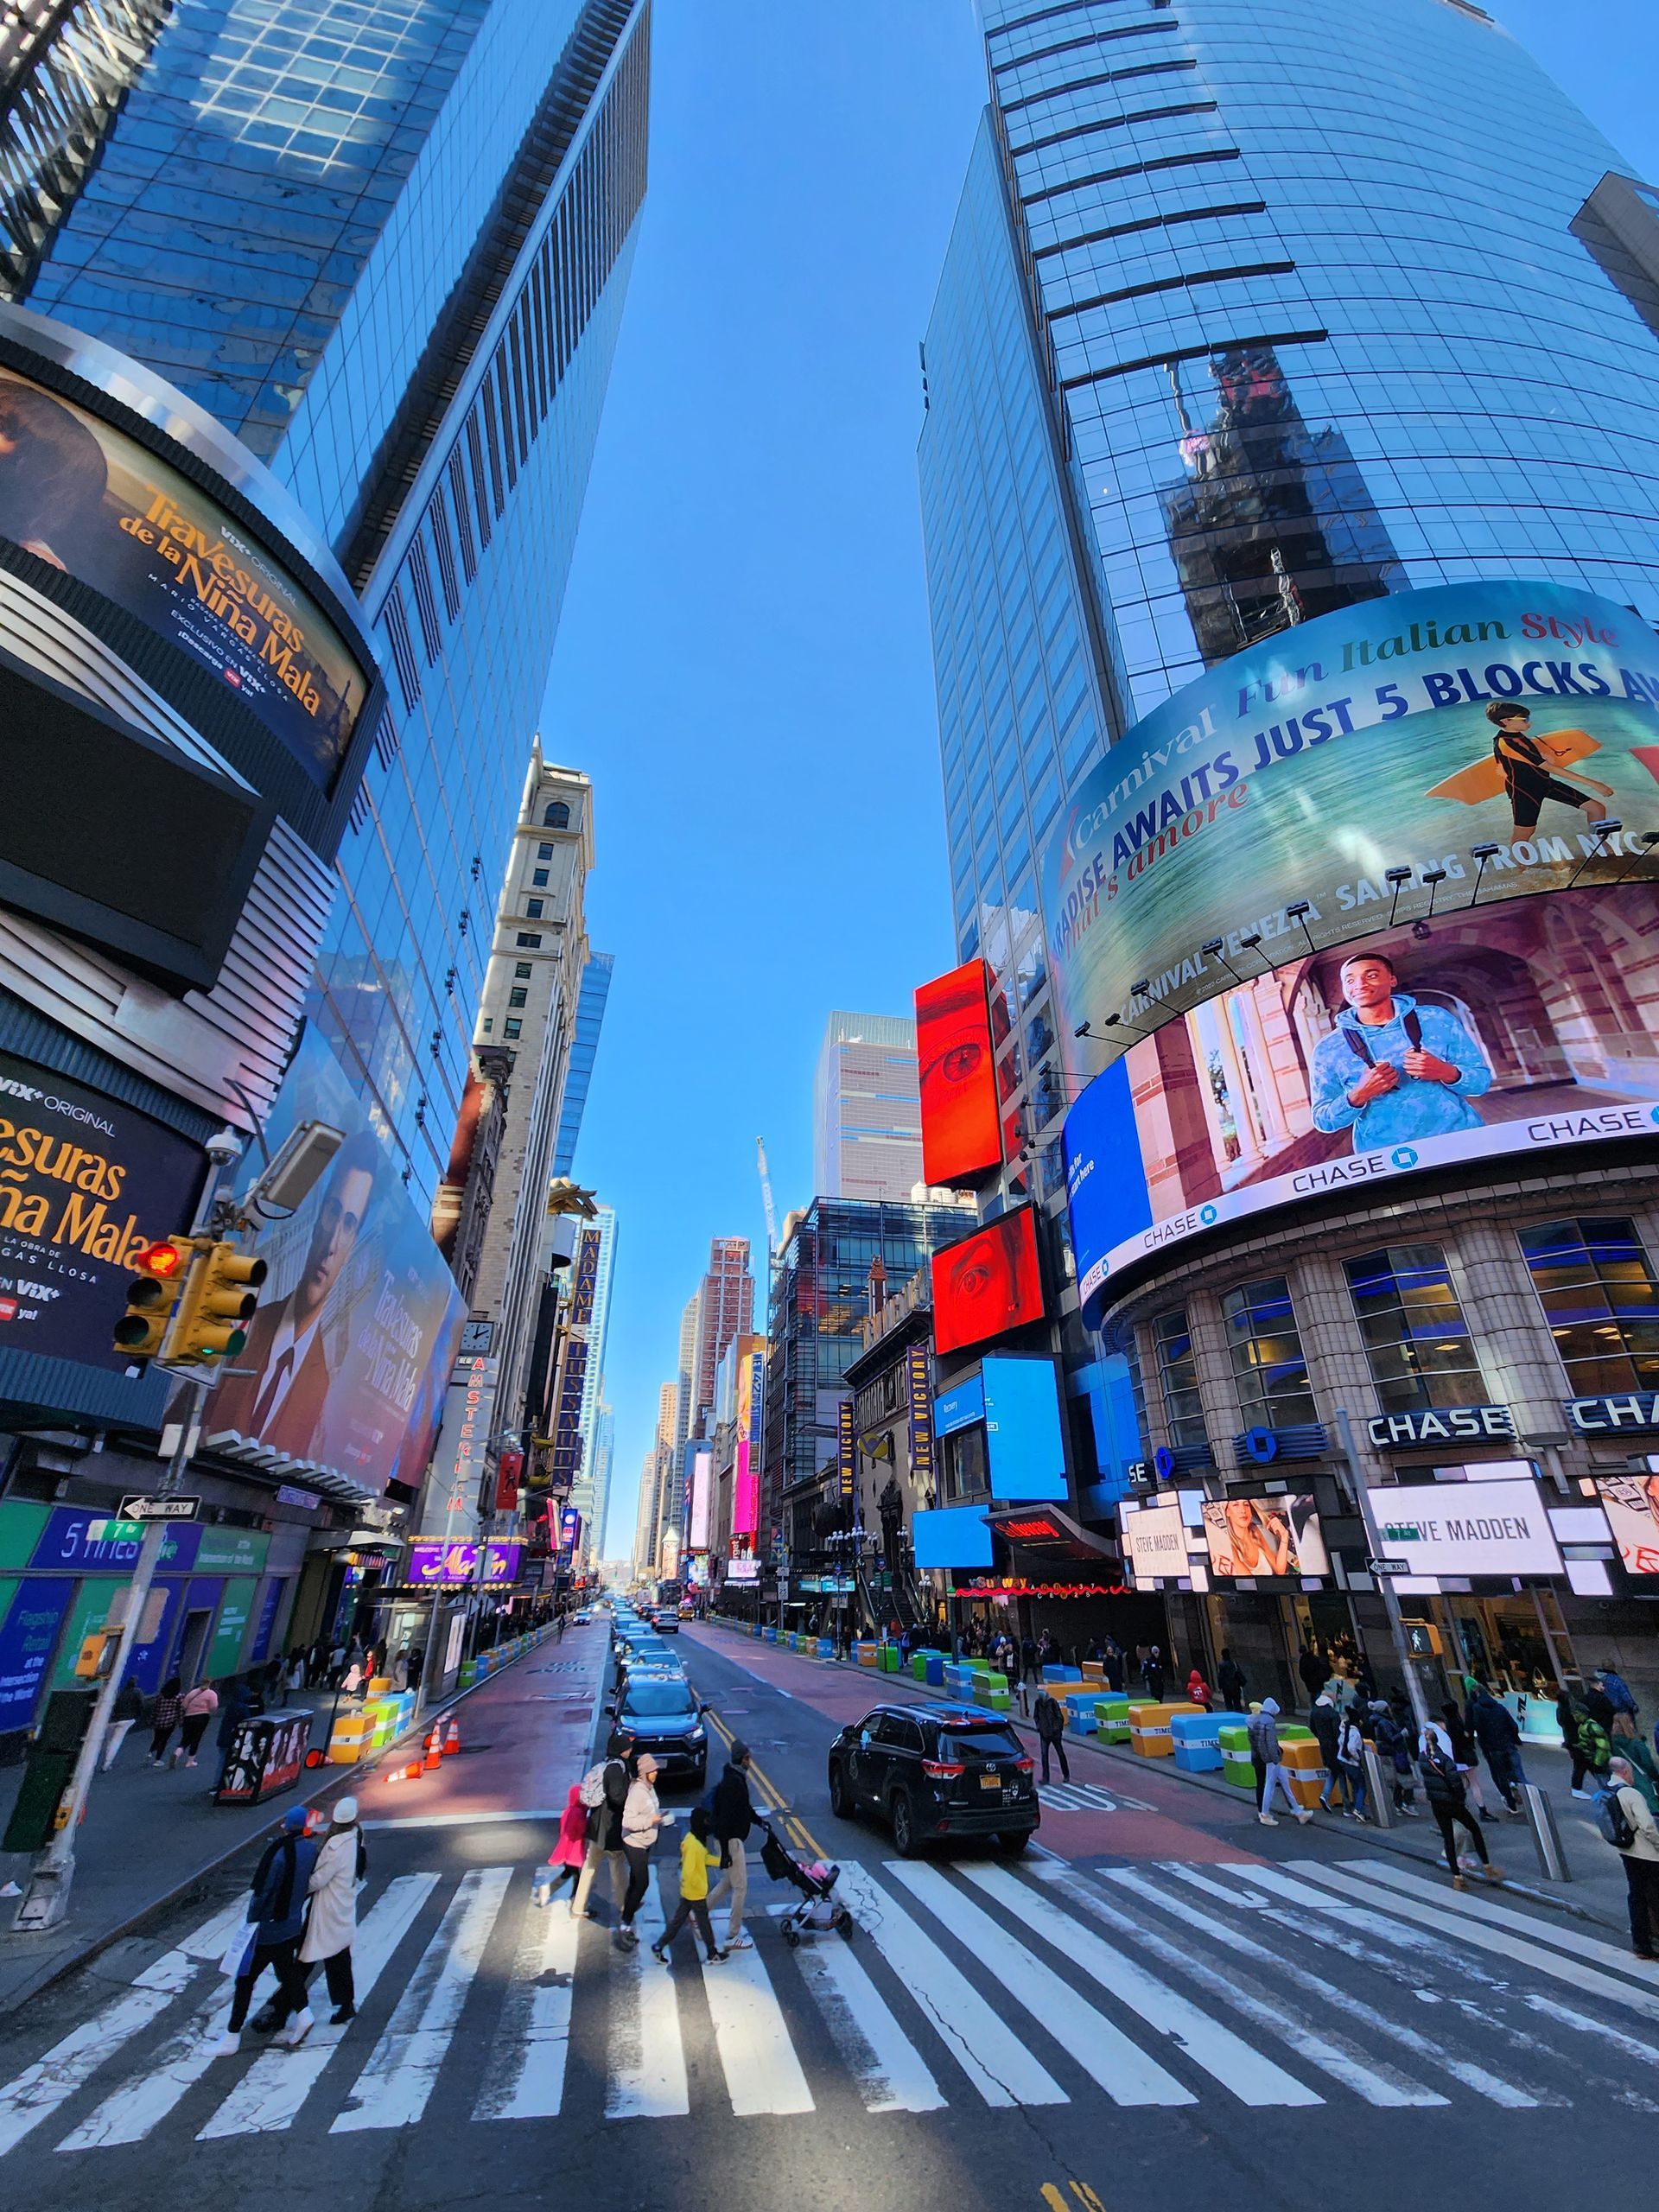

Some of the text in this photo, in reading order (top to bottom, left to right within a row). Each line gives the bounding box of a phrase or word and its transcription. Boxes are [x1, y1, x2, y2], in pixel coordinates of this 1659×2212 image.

[145, 484, 304, 652] Travesuras
[251, 556, 298, 608] ORIGINAL
[119, 517, 321, 716] de la Niña Mala
[148, 573, 289, 702] MARIO VARGAS LLOSA
[171, 609, 225, 656] EXCLUSIVO
[224, 654, 238, 669] EN
[1075, 612, 1620, 849] Carnival Fun Italian Style
[1112, 750, 1240, 872] AWAITS
[1253, 697, 1354, 768] JUST
[1375, 683, 1409, 721] 5
[1421, 661, 1611, 709] BLOCKS
[1127, 783, 1250, 881] amore
[1213, 899, 1322, 964] VENEZIA
[1335, 854, 1466, 911] SAILING
[1577, 830, 1647, 858] NYC
[1313, 927, 1339, 941] RIGHTS
[43, 1096, 116, 1139] ORIGINAL
[1527, 1109, 1649, 1142] CHASE
[1079, 1159, 1095, 1178] here
[1292, 1155, 1388, 1192] CHASE
[3, 1236, 61, 1258] LA OBRA DE
[52, 1191, 149, 1274] Mala
[1143, 1212, 1198, 1249] CHASE
[48, 1261, 97, 1284] LLOSA
[576, 1230, 601, 1324] MADAME
[1083, 1266, 1102, 1294] CHASE
[17, 1308, 38, 1320] ya!
[750, 1354, 763, 1373] NEW
[558, 1343, 583, 1486] TUSSAUDS
[912, 1351, 931, 1465] NEW VICTORY
[1571, 1395, 1659, 1429] CH
[1367, 1408, 1510, 1446] CHASE
[841, 1404, 853, 1494] NEW VICTORY
[1128, 1463, 1148, 1483] SE
[131, 1503, 188, 1514] ONE WAY
[60, 1522, 85, 1559] 5
[114, 1523, 123, 1538] 7
[1135, 1533, 1179, 1553] STEVE MADDEN
[1445, 1516, 1531, 1542] MADDEN
